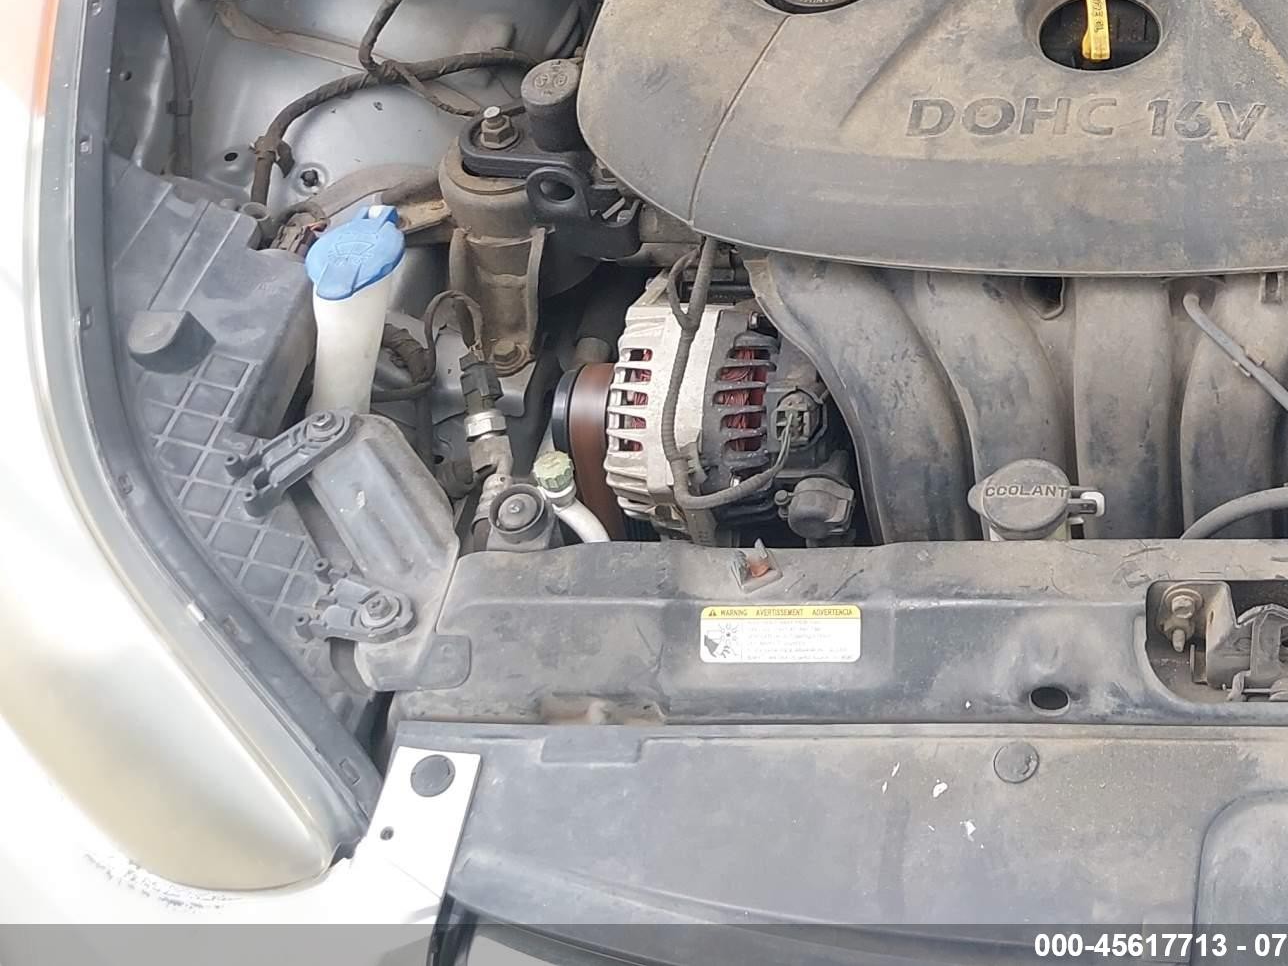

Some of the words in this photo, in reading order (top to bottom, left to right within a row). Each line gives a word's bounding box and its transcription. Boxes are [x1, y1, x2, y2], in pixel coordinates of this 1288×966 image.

[906, 97, 1117, 136] DOHC
[1147, 100, 1266, 140] 16V
[985, 485, 1068, 497] COOLANT
[720, 609, 748, 617] WARNING
[756, 609, 804, 617] AVERTISSEMENT
